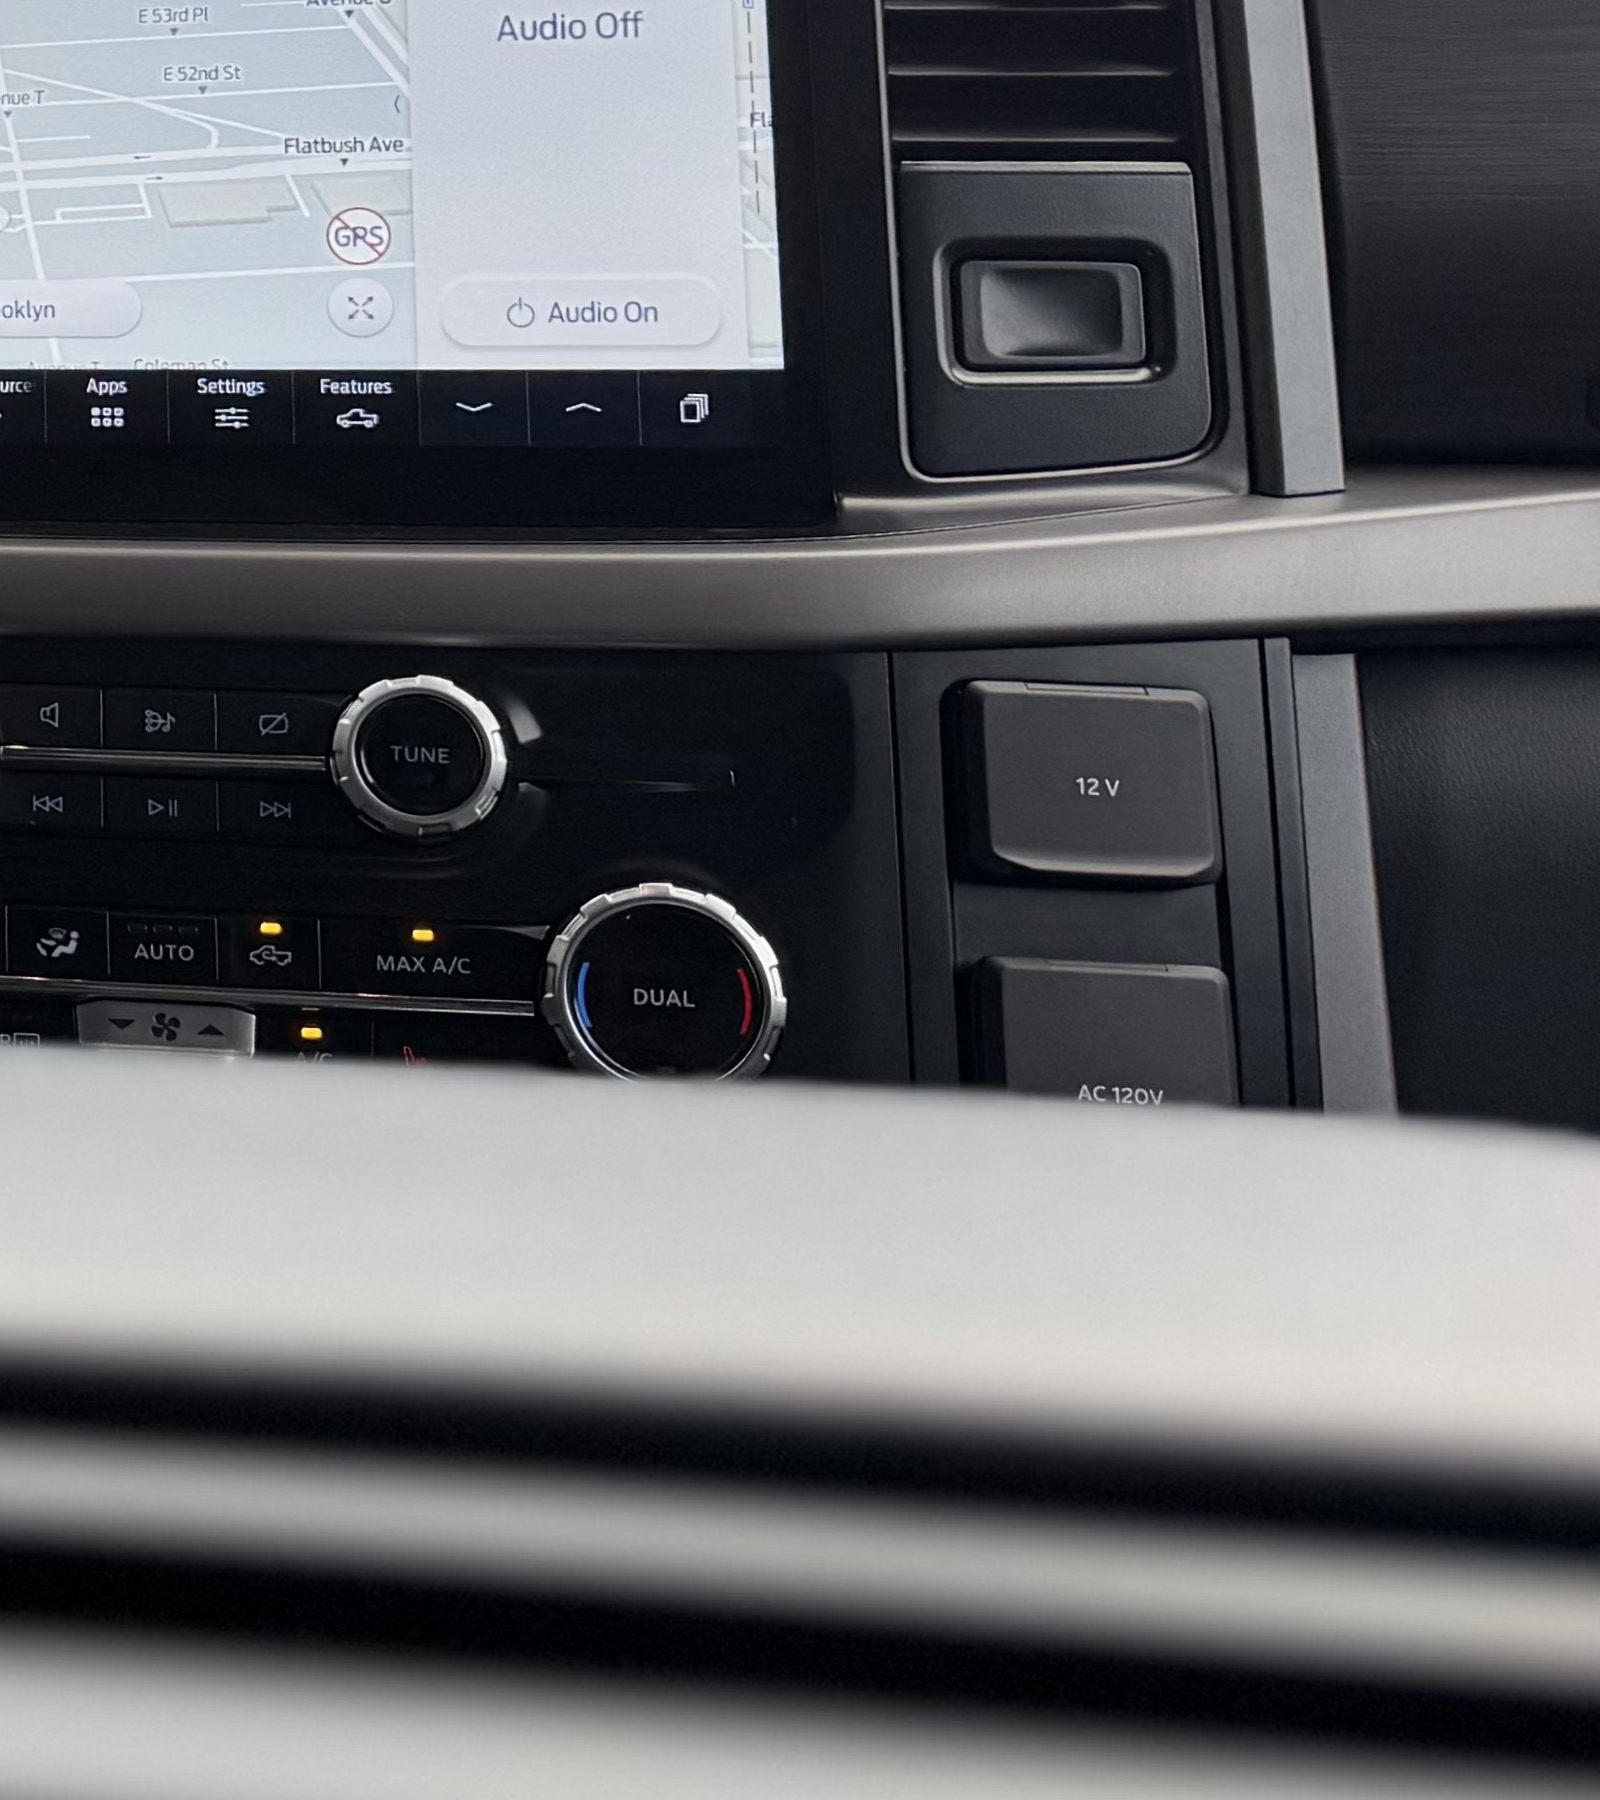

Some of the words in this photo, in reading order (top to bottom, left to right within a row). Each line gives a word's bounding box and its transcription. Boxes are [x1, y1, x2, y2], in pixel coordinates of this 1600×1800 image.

[139, 9, 147, 23] E
[150, 7, 188, 23] 53rd
[193, 7, 208, 22] Pl
[497, 13, 587, 42] Audio
[595, 11, 643, 38] Off
[163, 67, 173, 82] E
[177, 66, 217, 82] 52nd
[223, 65, 241, 80] St
[34, 90, 45, 104] T
[284, 138, 365, 154] Flatbush
[369, 137, 404, 153] Ave
[334, 225, 384, 248] GPS
[548, 303, 618, 324] Audio
[624, 302, 658, 323] On
[86, 378, 127, 396] Apps
[197, 378, 265, 397] Settings
[320, 378, 393, 395] Features
[391, 746, 450, 764] TUNE
[1076, 778, 1099, 795] 12
[1105, 779, 1119, 796] V
[134, 944, 195, 961] AUTO
[376, 955, 425, 973] MAX
[432, 956, 471, 976] A/C
[634, 988, 695, 1008] DUAL
[1078, 1084, 1106, 1102] AC
[1112, 1086, 1164, 1106] 120V
